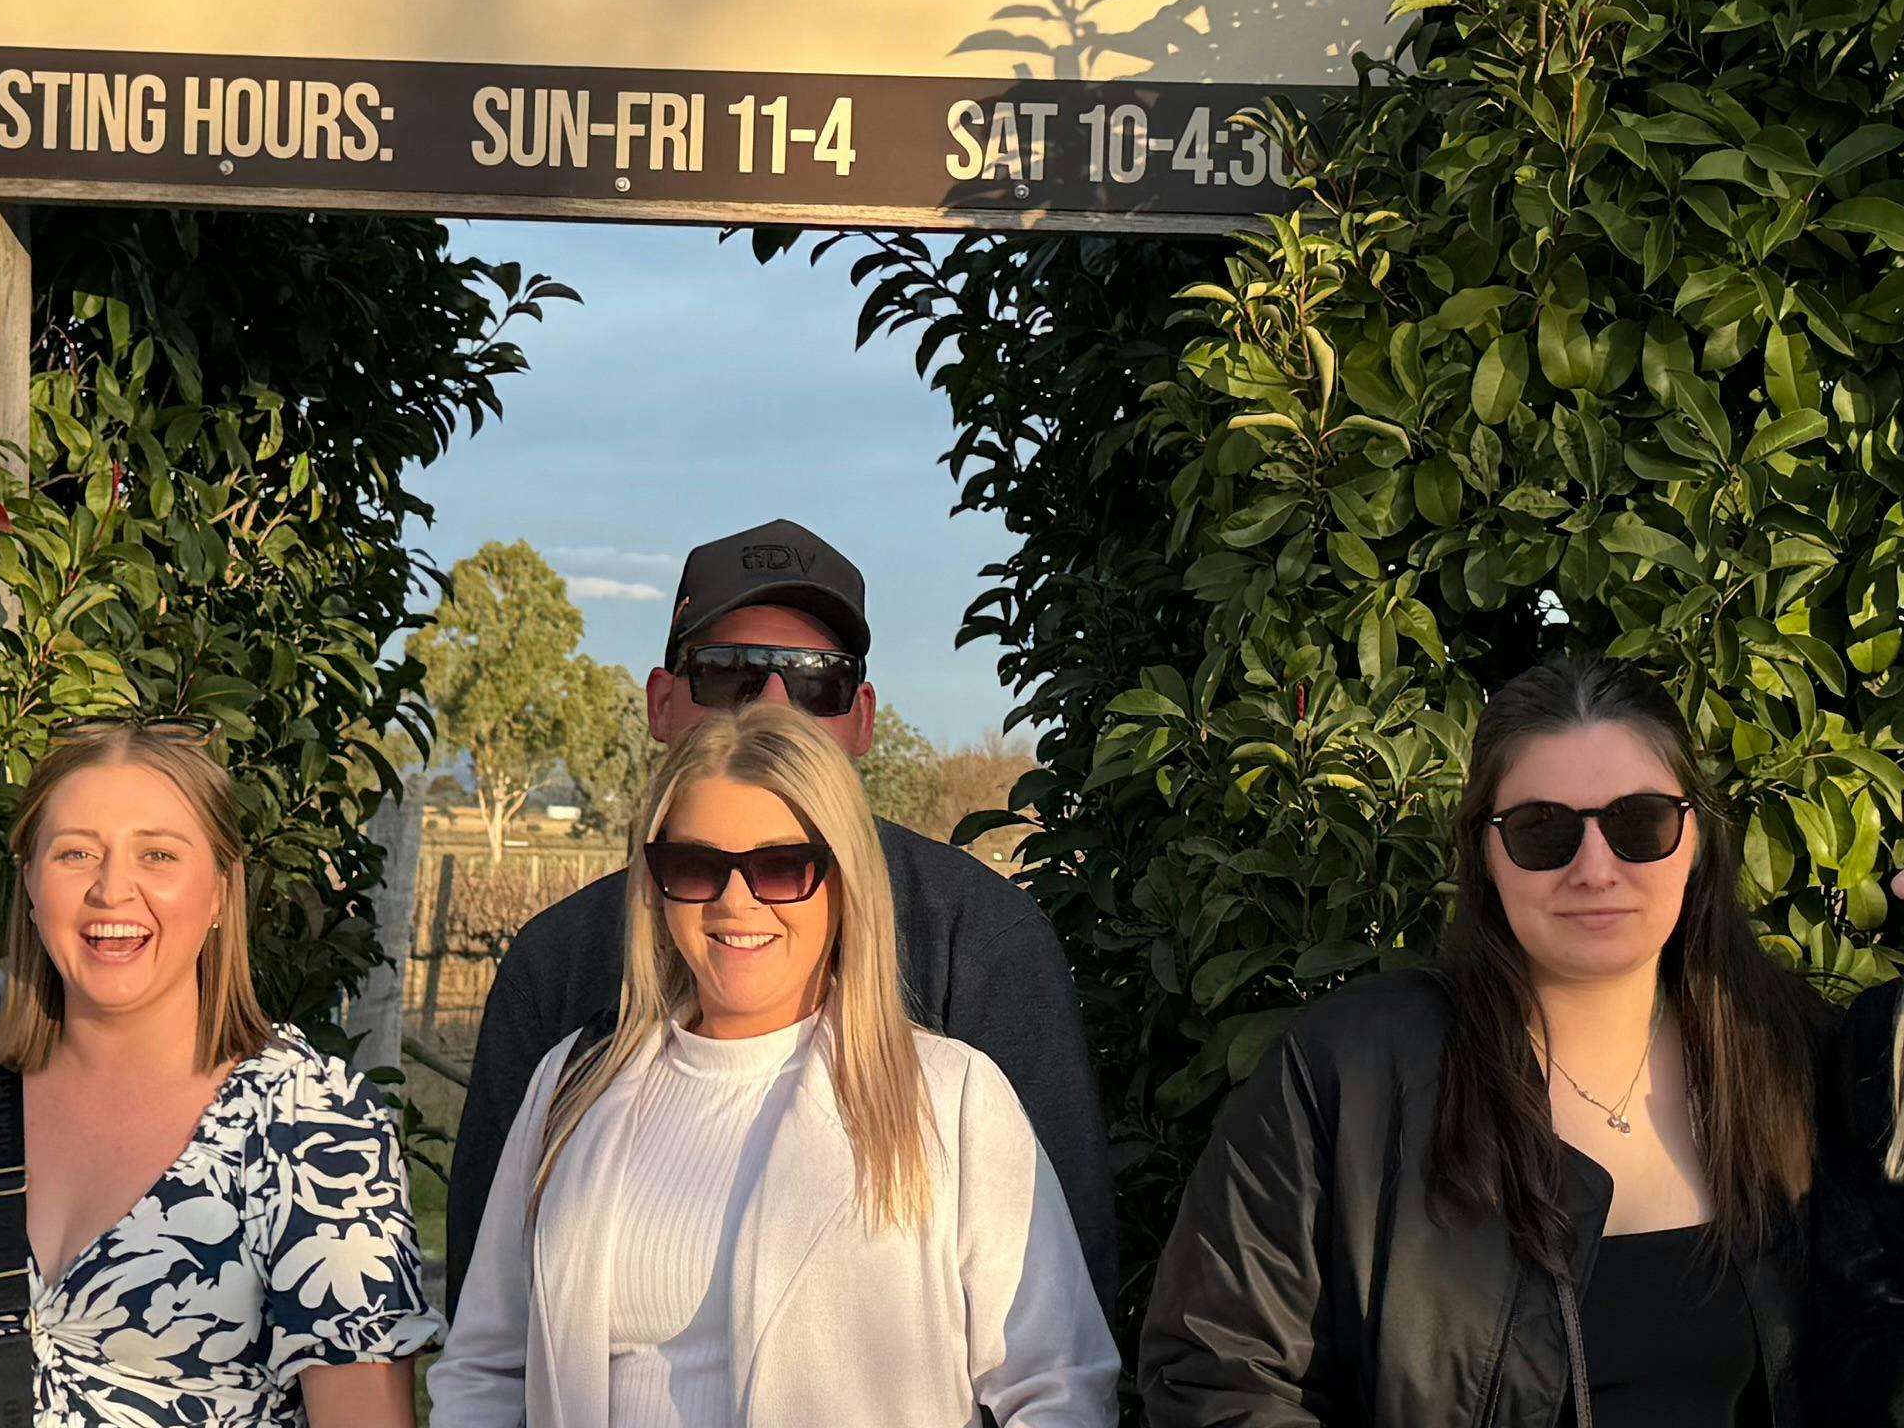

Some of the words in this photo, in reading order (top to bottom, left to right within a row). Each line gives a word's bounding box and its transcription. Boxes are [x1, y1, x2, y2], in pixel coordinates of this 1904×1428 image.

[184, 76, 394, 162] HOURS:
[471, 87, 705, 171] SUN-FRI
[727, 95, 857, 177] 11-4
[945, 99, 1059, 181] SAT
